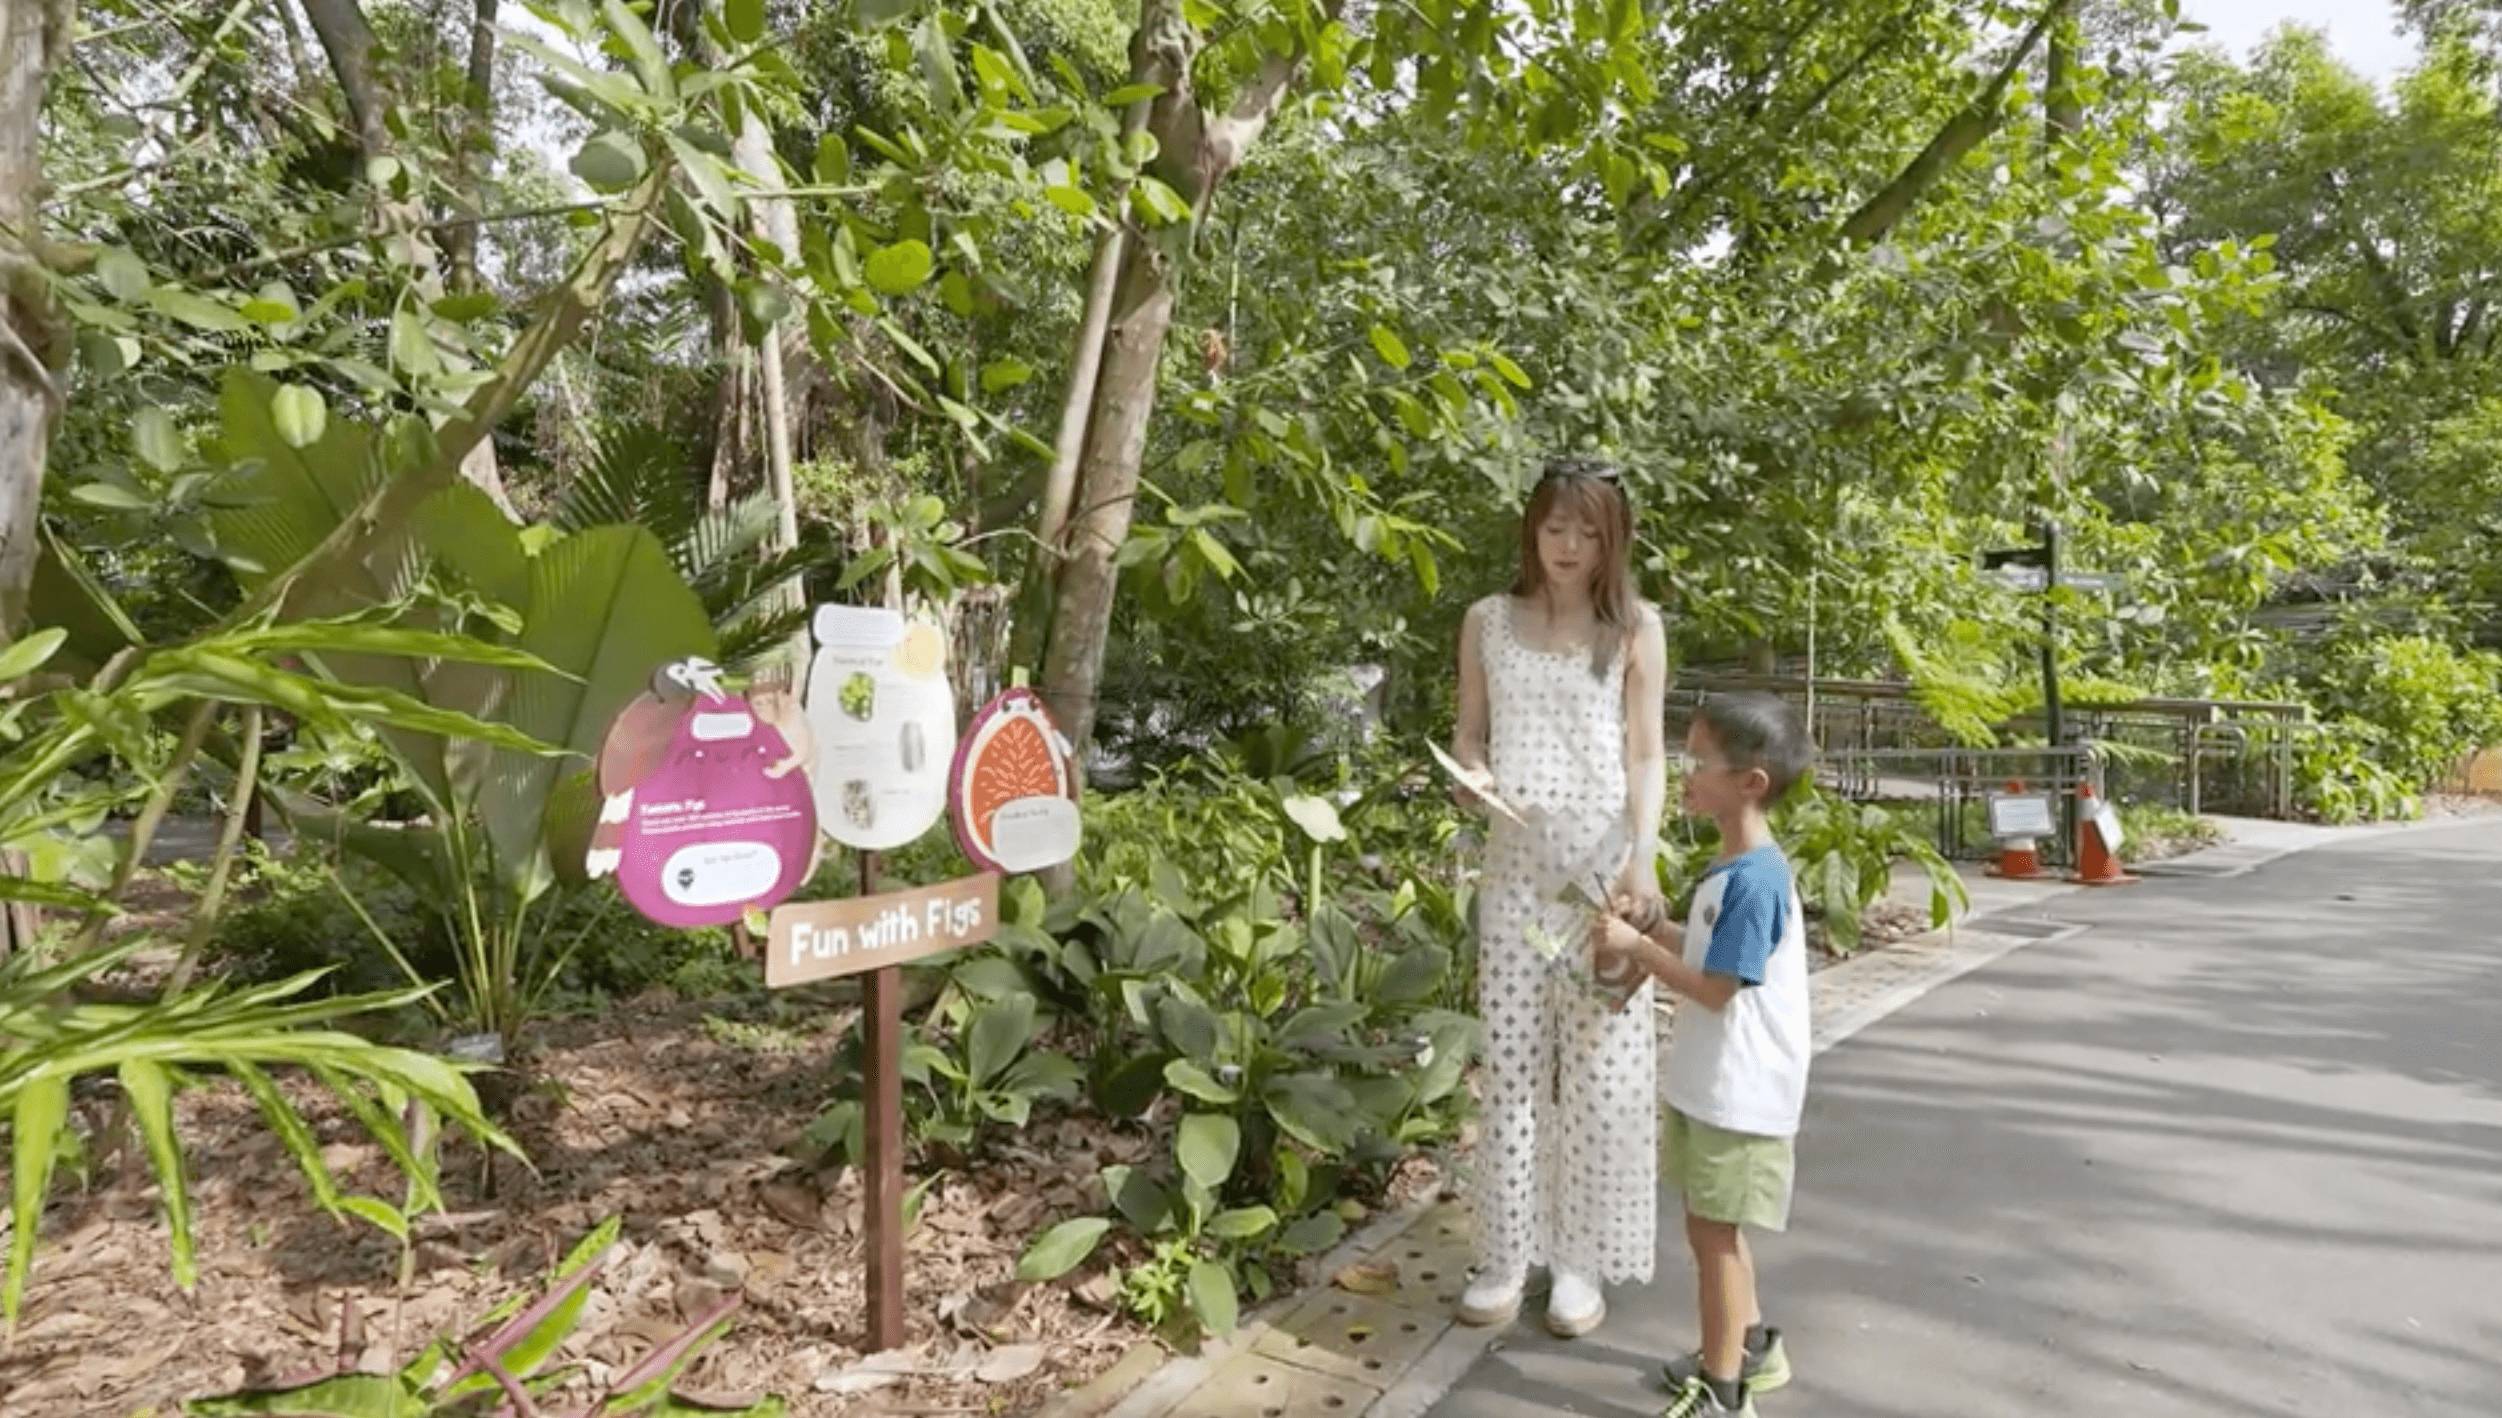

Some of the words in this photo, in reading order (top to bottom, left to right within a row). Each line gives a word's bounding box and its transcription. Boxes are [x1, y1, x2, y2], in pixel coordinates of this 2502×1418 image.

[791, 922, 848, 966] Fun
[858, 904, 918, 949] with
[927, 898, 981, 938] Figs
